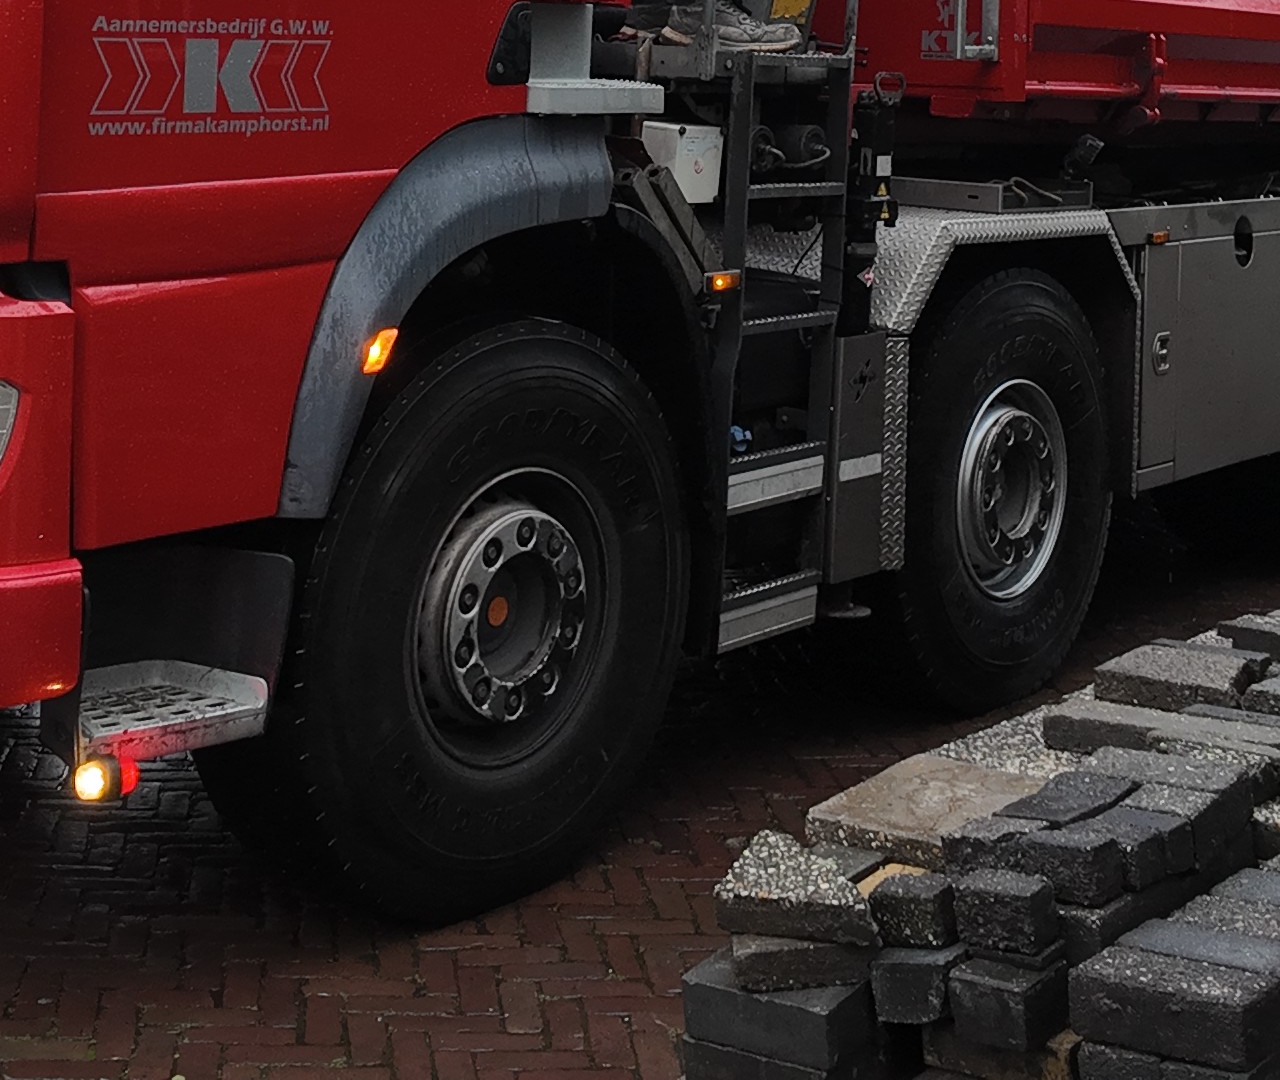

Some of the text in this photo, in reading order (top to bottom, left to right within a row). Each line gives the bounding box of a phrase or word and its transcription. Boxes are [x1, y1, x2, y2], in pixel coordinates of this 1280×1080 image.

[91, 15, 334, 39] Aannemersbedrijf G.W.W.
[88, 115, 330, 137] www.firmakamphorst.nl
